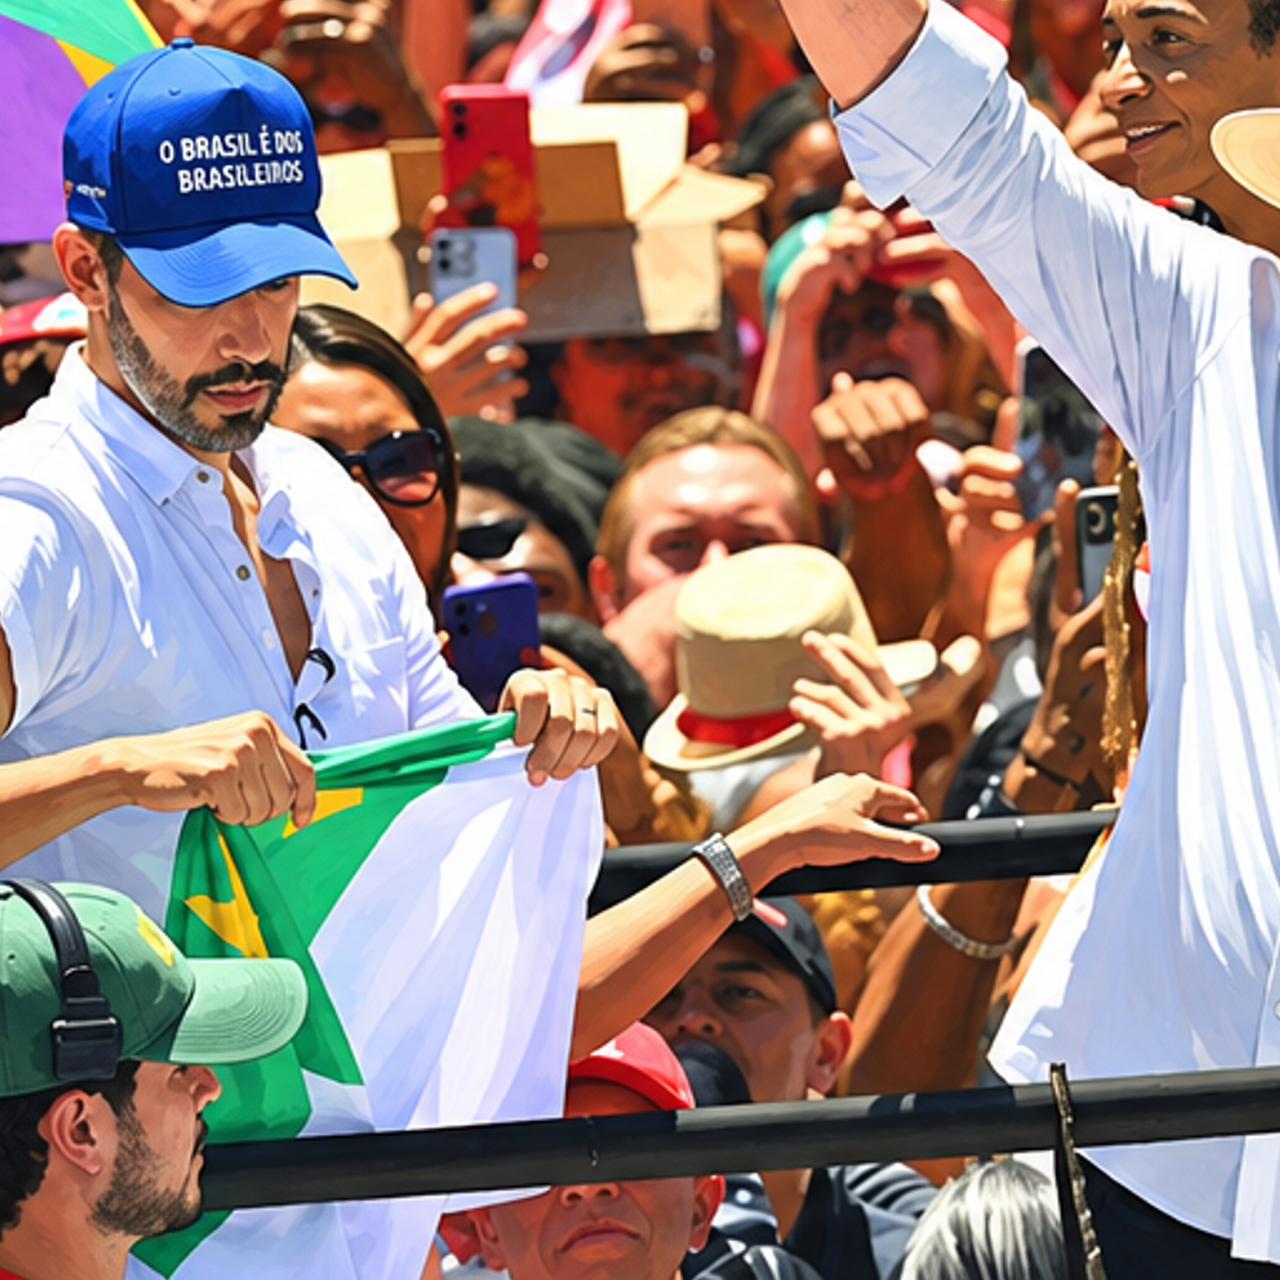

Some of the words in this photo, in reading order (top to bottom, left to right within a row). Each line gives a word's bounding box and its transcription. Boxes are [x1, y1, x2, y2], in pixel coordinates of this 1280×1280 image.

[159, 140, 174, 163] O
[180, 132, 257, 161] BRASIL
[259, 124, 272, 155] É
[274, 130, 303, 154] DOS
[177, 160, 303, 194] BRASILEIROS
